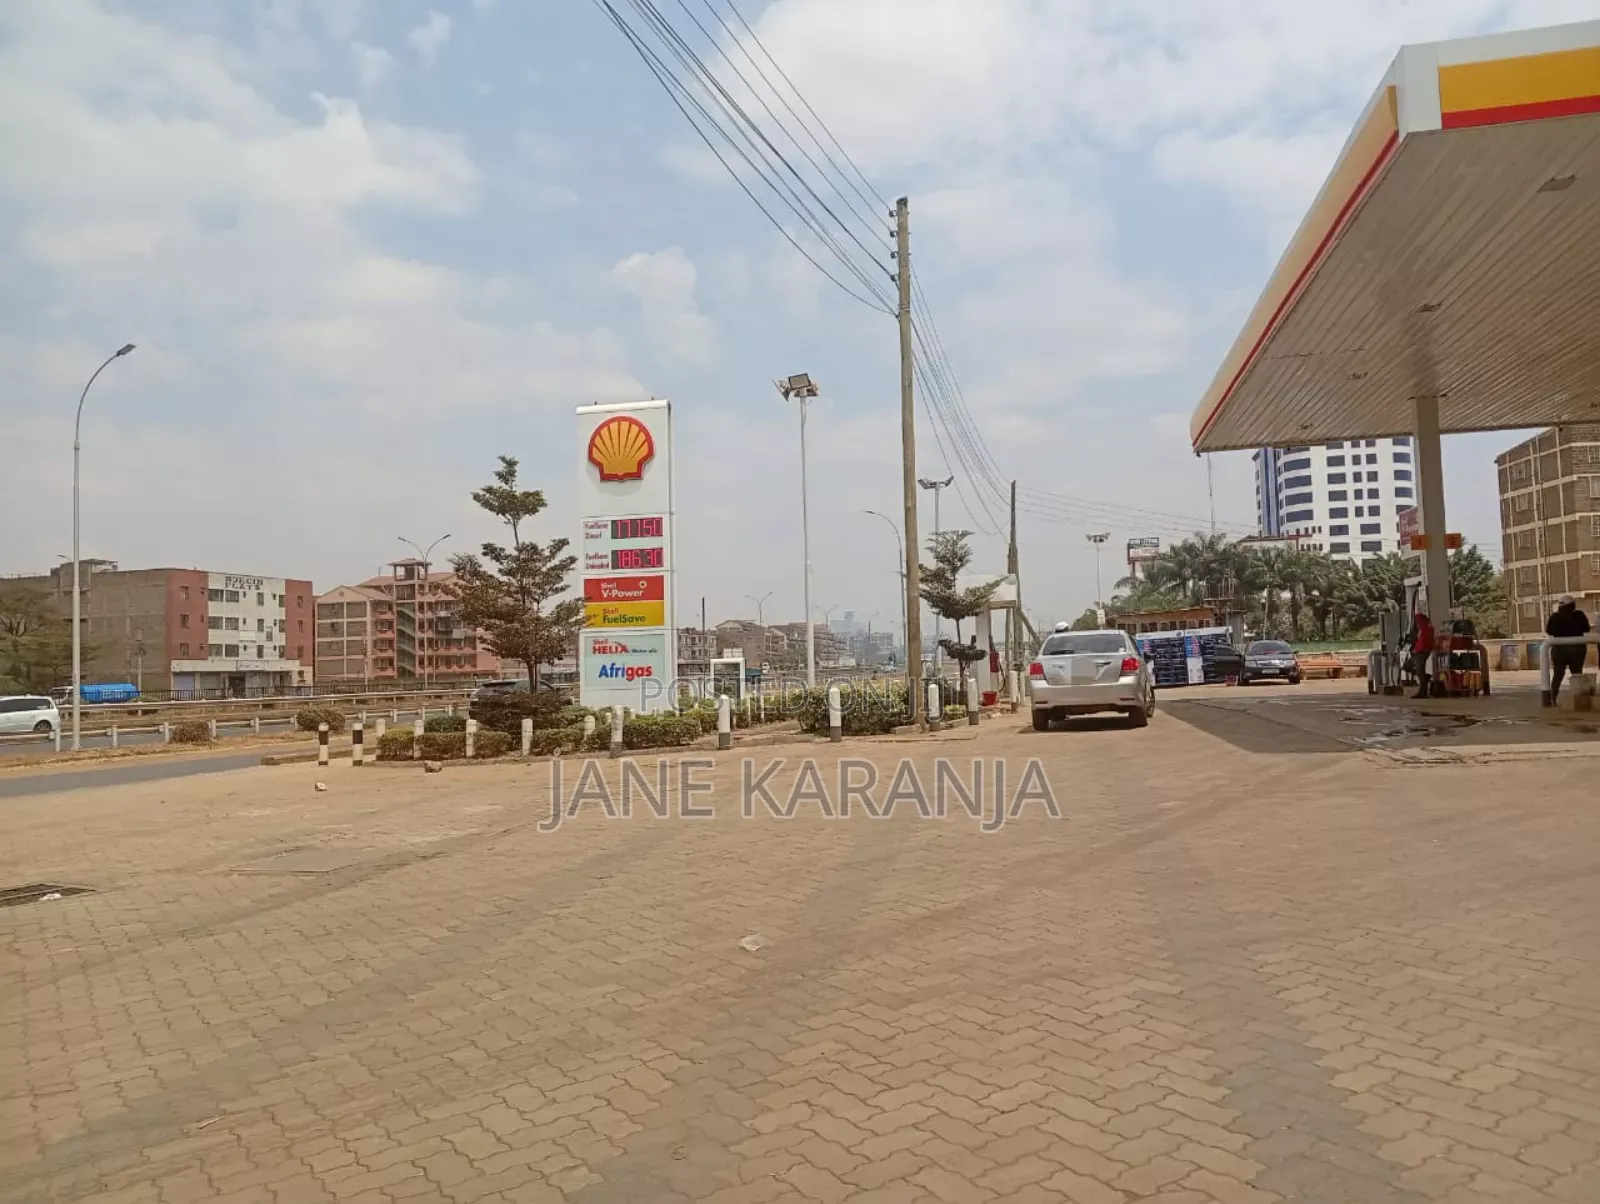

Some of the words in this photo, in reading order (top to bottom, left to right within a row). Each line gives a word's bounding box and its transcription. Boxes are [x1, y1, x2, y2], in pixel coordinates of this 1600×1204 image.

[601, 589, 645, 599] V-Power
[602, 607, 619, 615] Shell
[602, 614, 646, 624] FuelSave
[592, 644, 629, 655] HELIX
[598, 661, 653, 682] Afrigas
